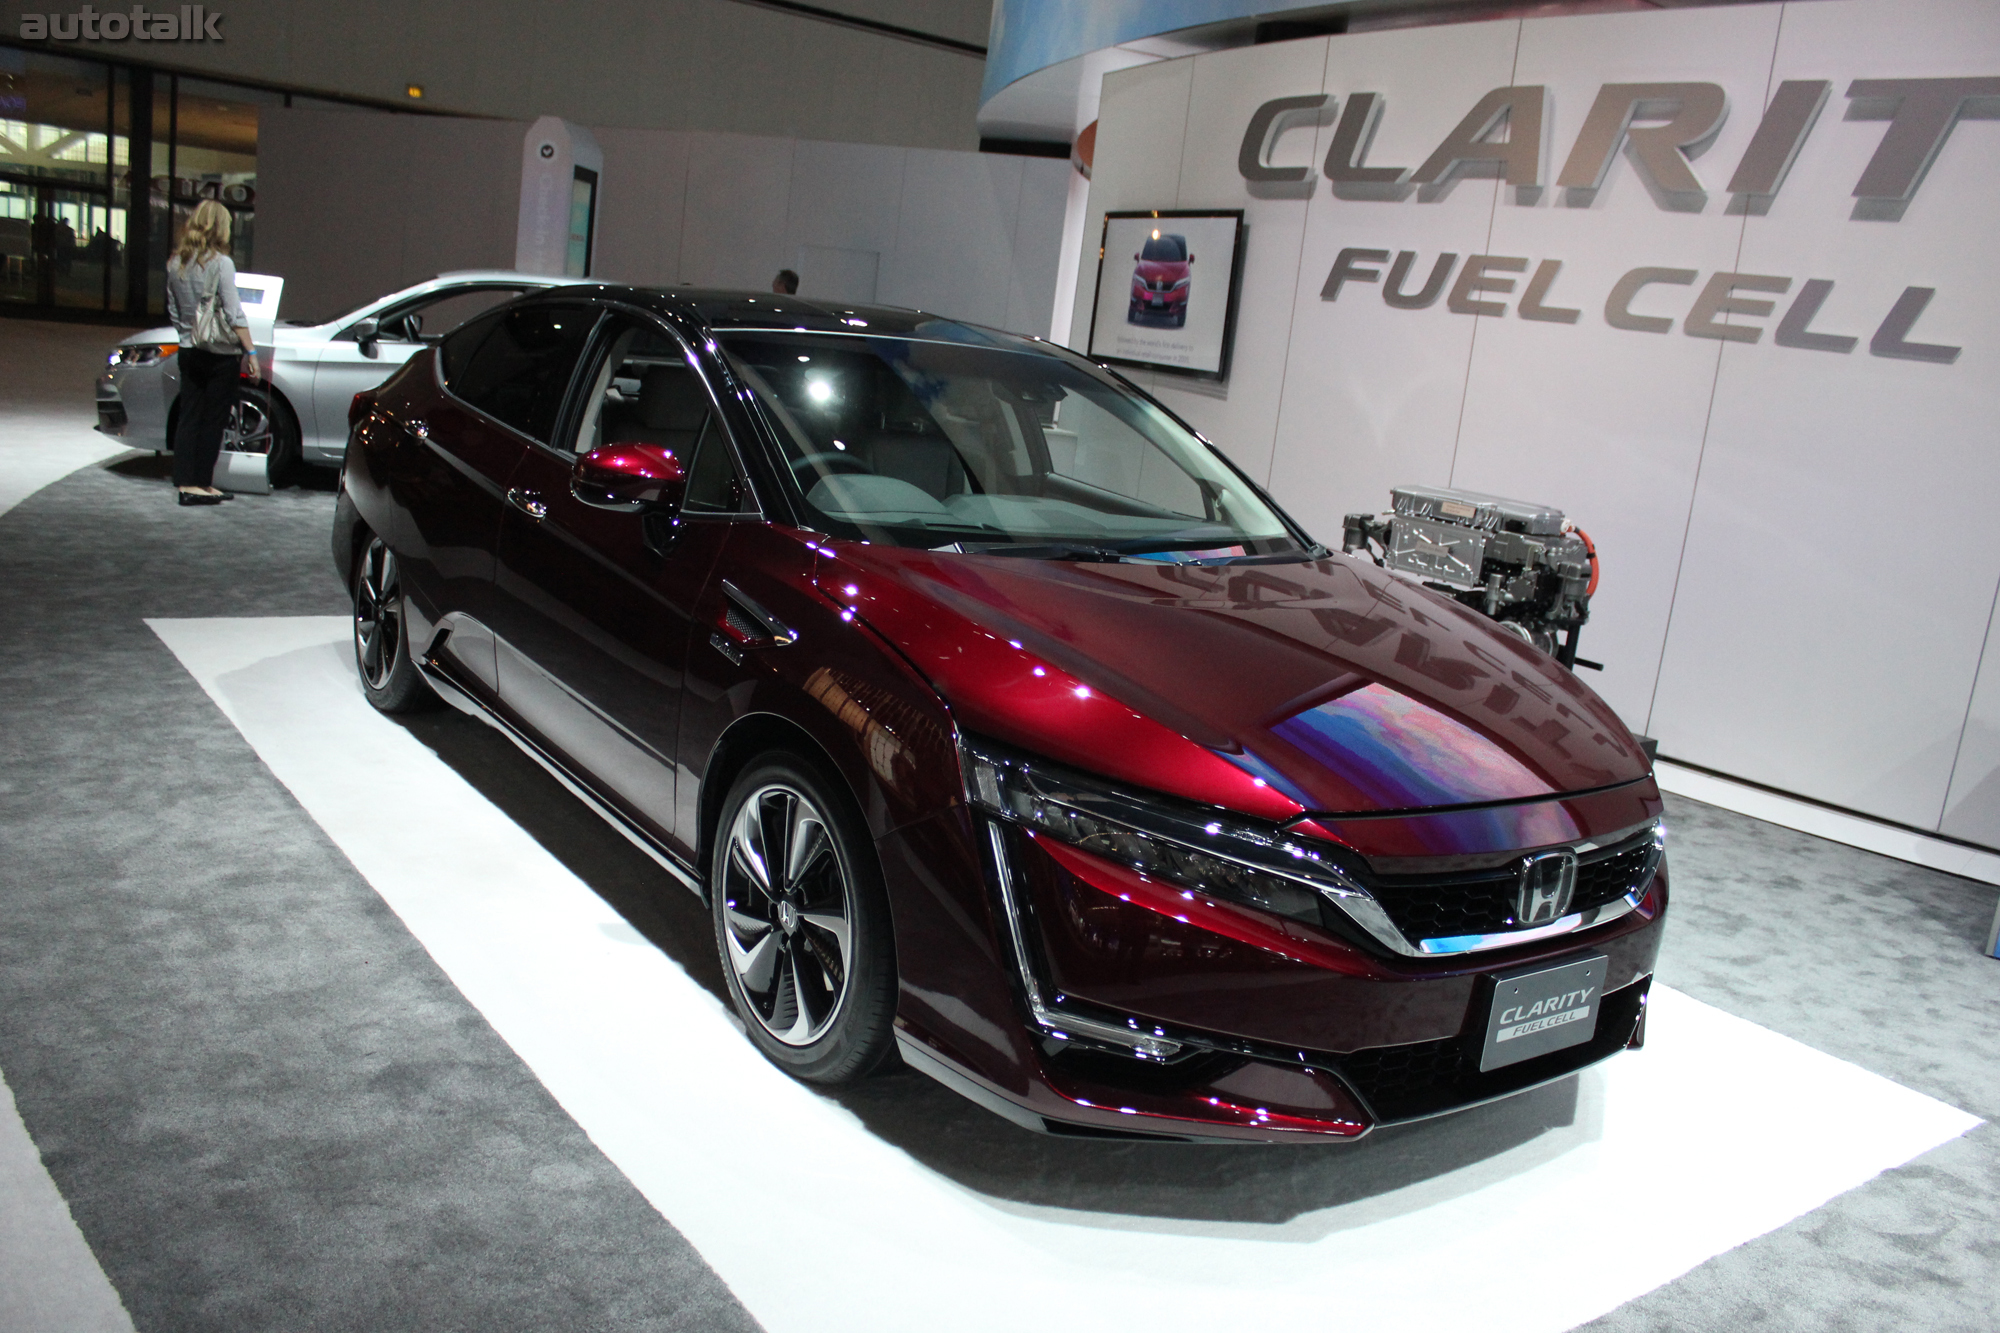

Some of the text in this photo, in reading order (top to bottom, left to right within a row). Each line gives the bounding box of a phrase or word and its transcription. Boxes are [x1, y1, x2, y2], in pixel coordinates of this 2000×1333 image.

[1238, 76, 2000, 202] CLARIT
[1320, 247, 1962, 364] FUEL CELL
[1499, 986, 1596, 1025] CLARITY
[1513, 1012, 1576, 1037] FUEL CELL
